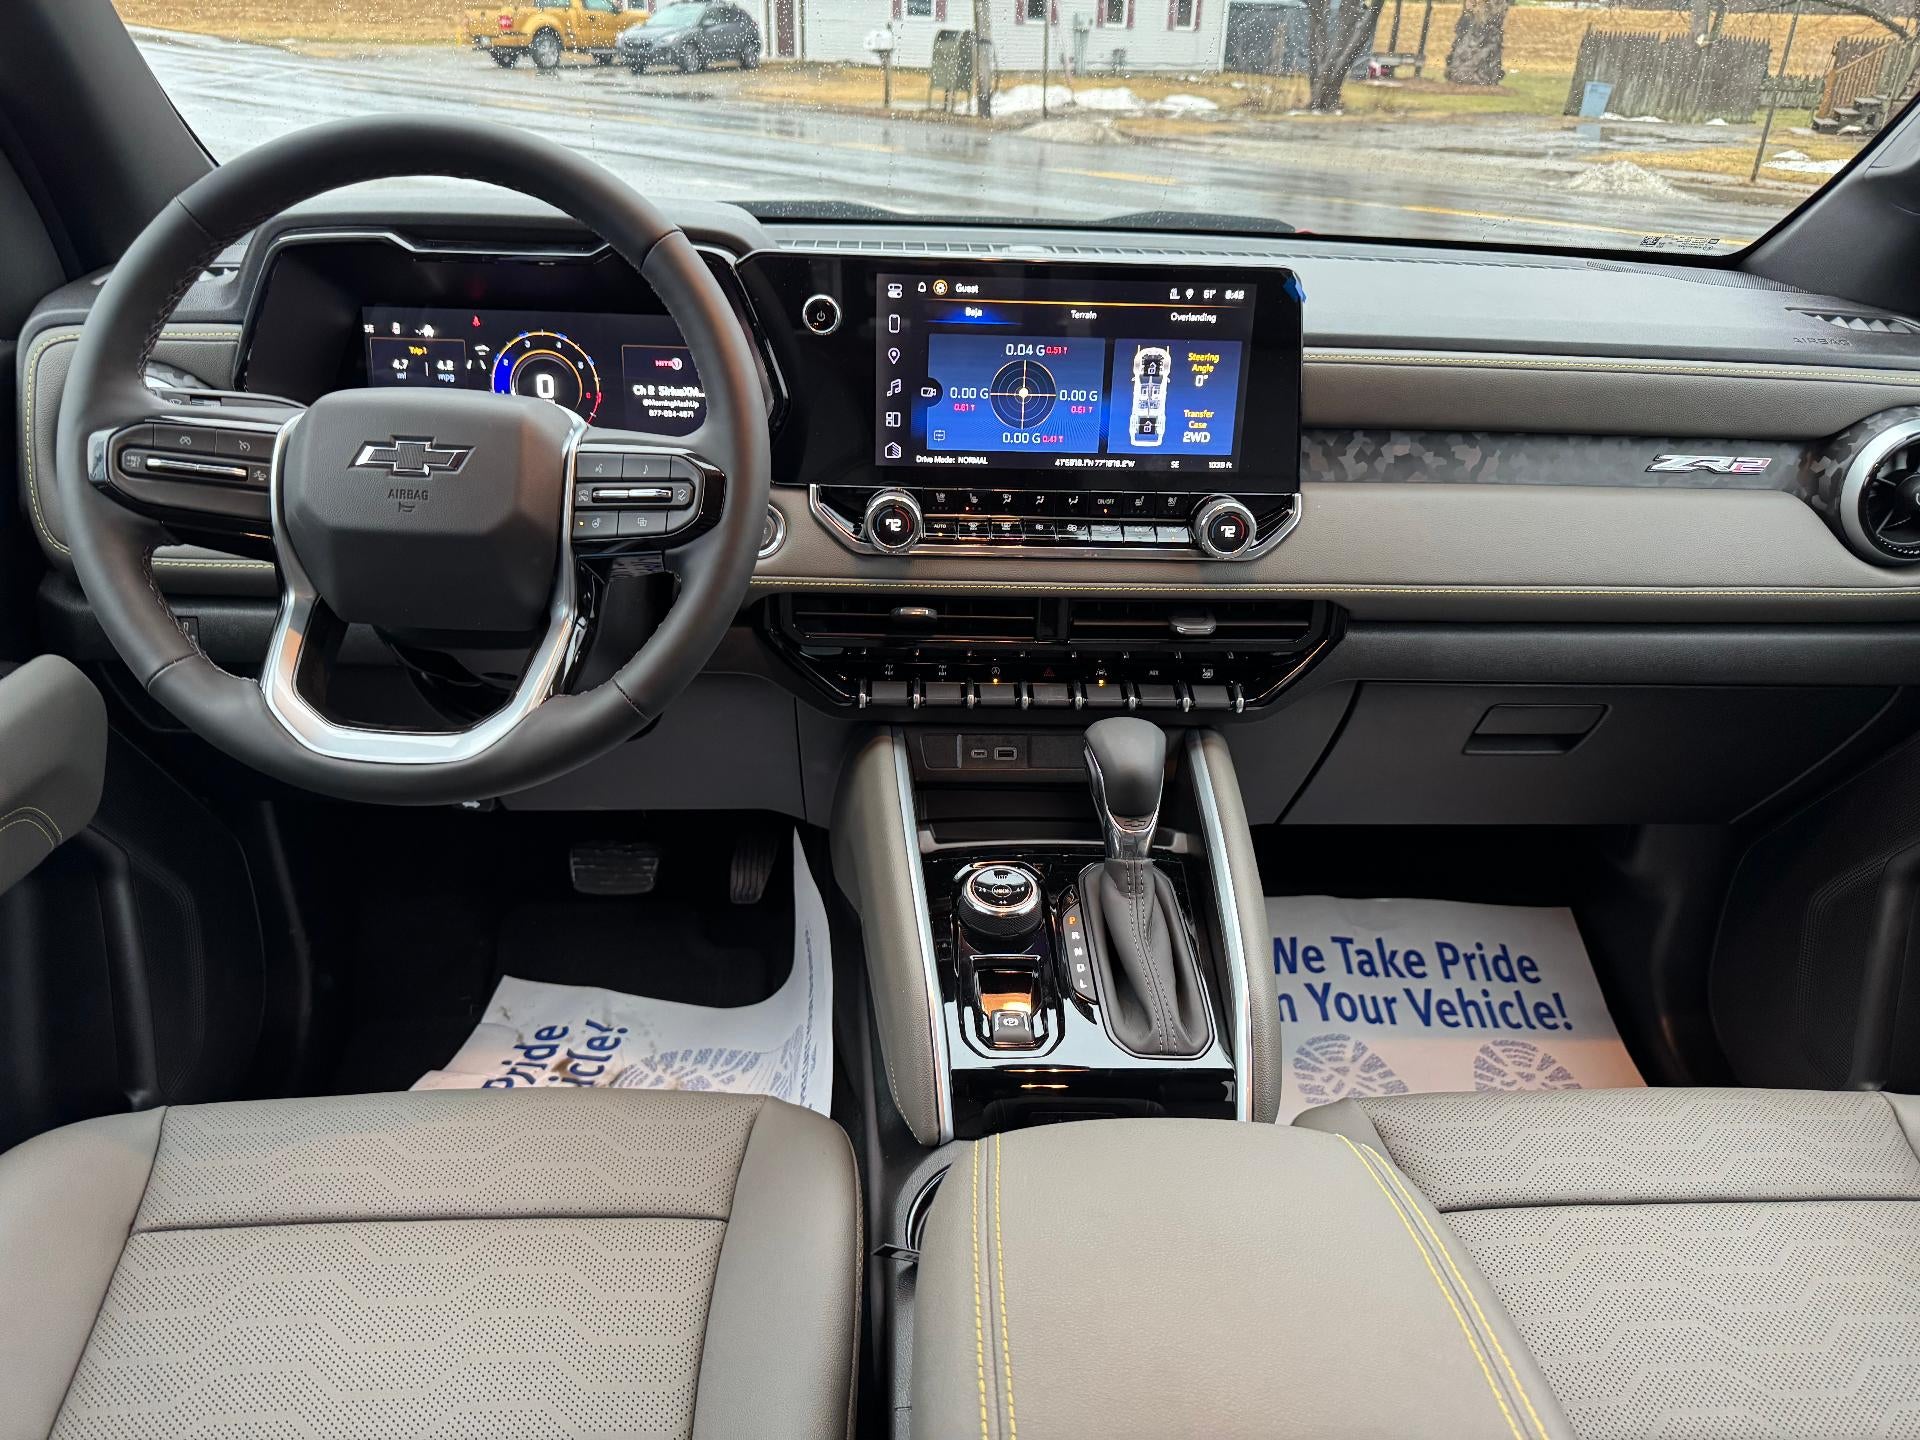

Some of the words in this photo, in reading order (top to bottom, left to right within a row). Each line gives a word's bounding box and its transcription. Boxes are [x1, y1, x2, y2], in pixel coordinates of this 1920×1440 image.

[955, 283, 979, 294] Guest
[965, 307, 983, 318] Baja
[1070, 310, 1098, 320] Terrain
[1170, 312, 1217, 324] Overlanding
[1005, 343, 1034, 356] 0.04
[1035, 343, 1045, 356] G
[1188, 352, 1220, 363] Steering
[1191, 364, 1214, 374] Angle
[438, 373, 455, 383] mpg
[536, 373, 555, 399] 0
[632, 384, 647, 396] Ch
[950, 387, 977, 400] 0.00
[979, 387, 989, 400] G
[1059, 390, 1087, 402] 0.00
[1088, 390, 1098, 402] G
[1183, 409, 1215, 418] Transfer
[1188, 420, 1208, 429] Case
[1002, 432, 1029, 444] 0.00
[1031, 432, 1041, 444] G
[1182, 431, 1211, 443] 2WD
[916, 455, 934, 464] Drive
[933, 455, 956, 465] Mode:
[957, 456, 988, 465] NORMAL
[1170, 460, 1180, 469] SE
[1645, 454, 1773, 475] ZR2
[387, 488, 429, 501] AIRBAG
[1069, 916, 1076, 924] P
[1072, 931, 1080, 939] R
[1074, 947, 1083, 956] N
[1330, 935, 1427, 979] Take
[1434, 940, 1541, 984] Pride
[1077, 963, 1086, 972] D
[1080, 979, 1087, 988] L
[1277, 993, 1298, 1022] n
[1303, 982, 1397, 1025] Your
[1402, 986, 1573, 1031] Vehicle!
